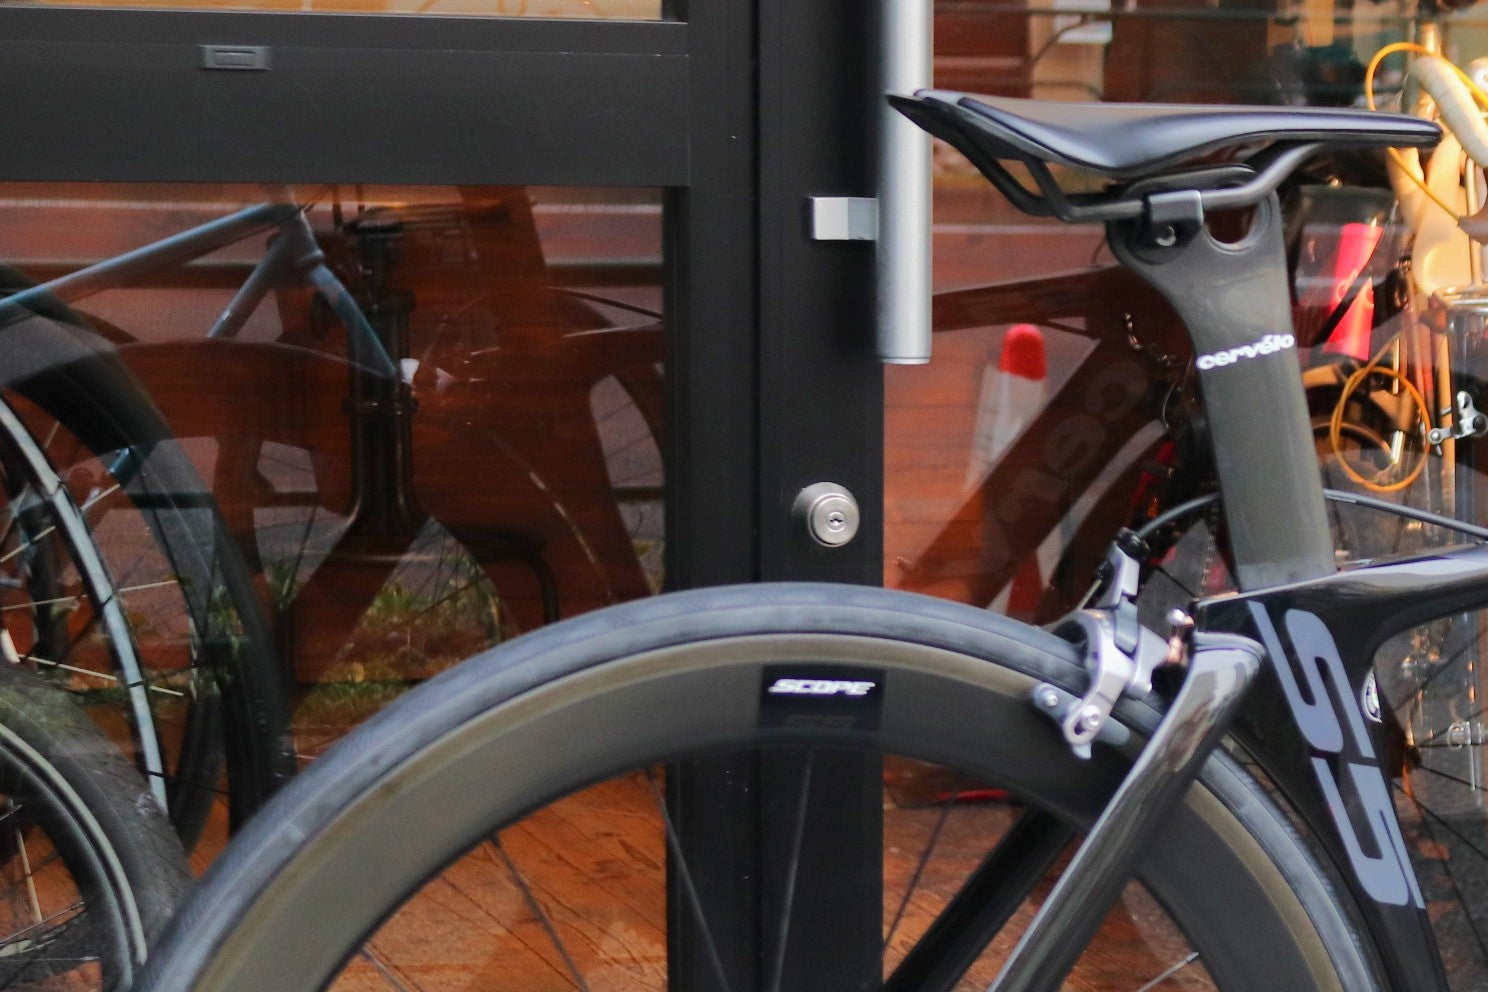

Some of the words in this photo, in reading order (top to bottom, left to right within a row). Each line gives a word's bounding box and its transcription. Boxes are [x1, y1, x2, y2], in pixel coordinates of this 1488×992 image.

[1196, 334, 1295, 370] cervélo
[768, 679, 876, 695] SCOPE
[1247, 600, 1426, 909] S5
